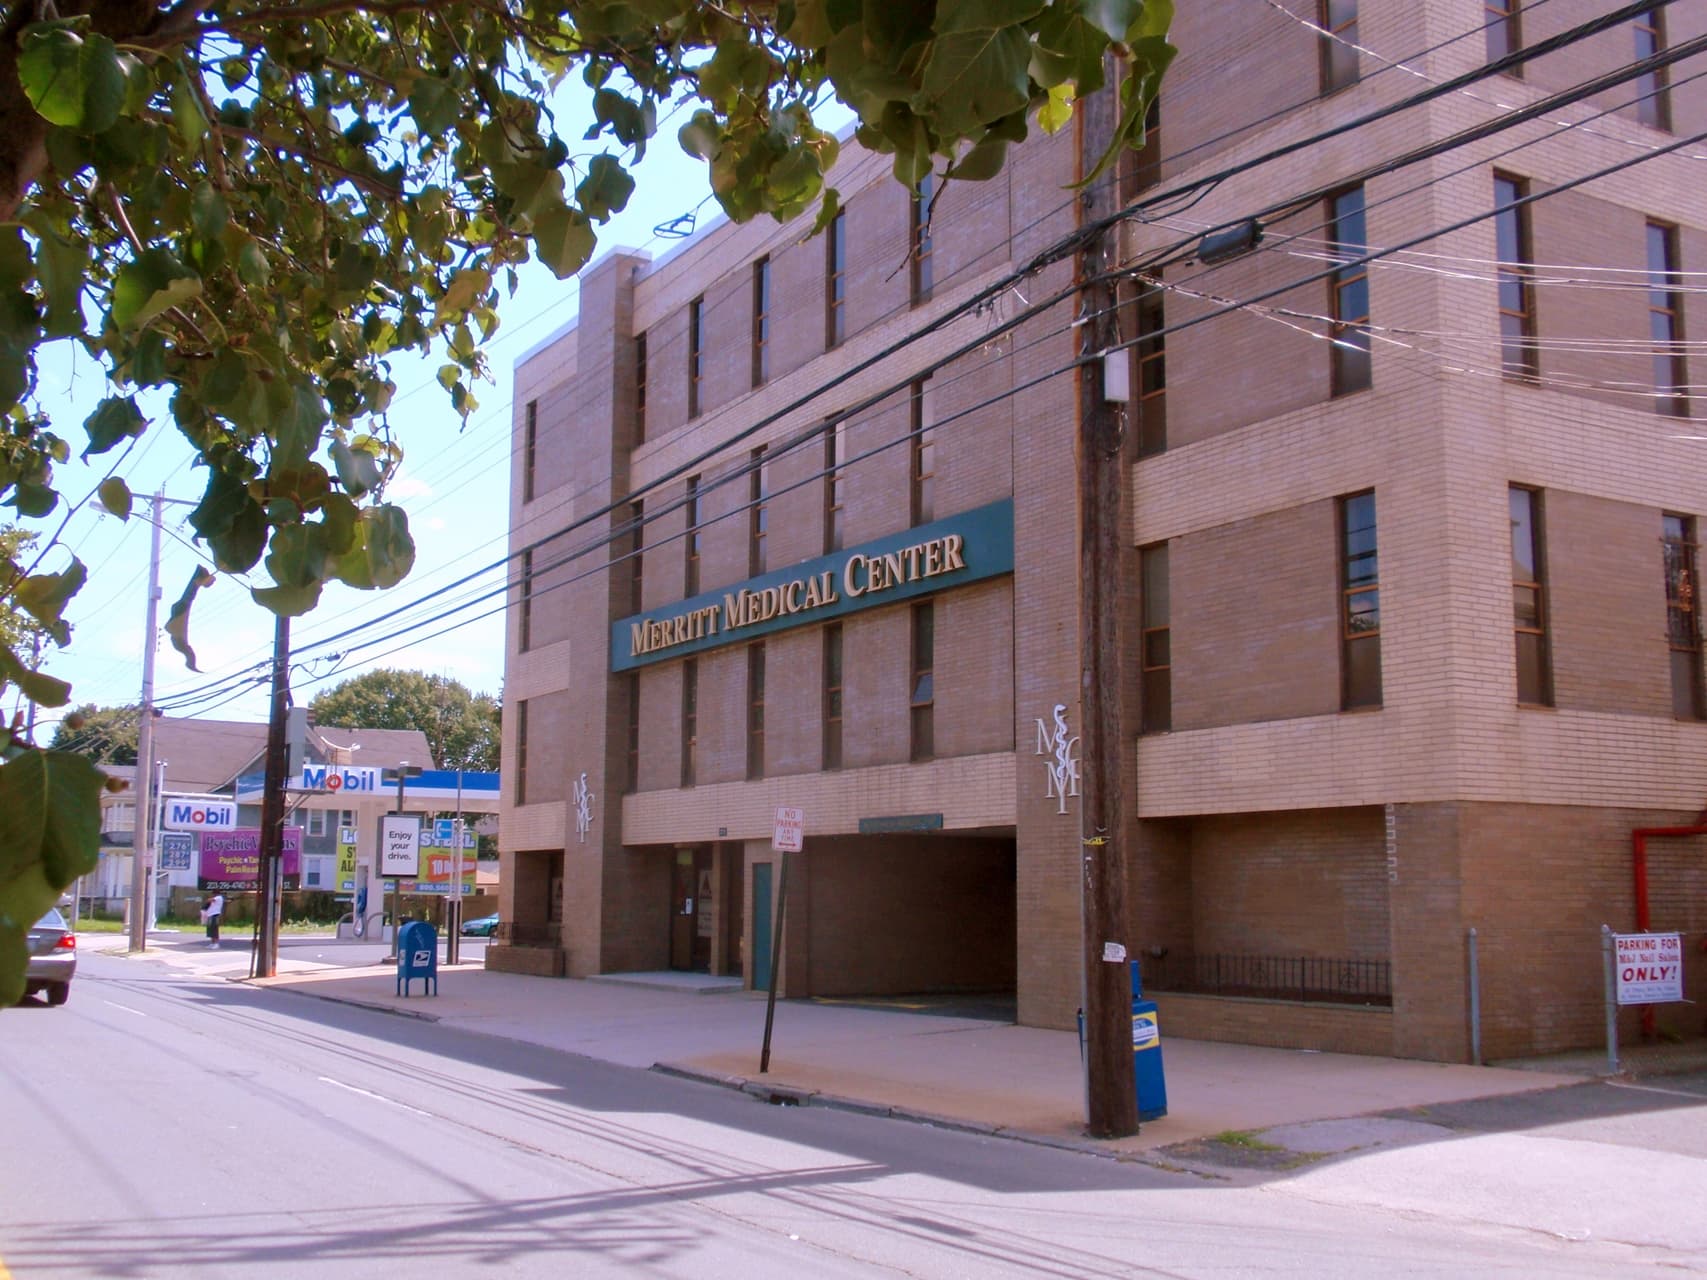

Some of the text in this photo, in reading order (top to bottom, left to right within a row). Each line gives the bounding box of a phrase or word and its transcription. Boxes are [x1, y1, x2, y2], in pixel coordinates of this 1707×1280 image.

[630, 533, 967, 656] MERRITT MEDICAL CENTER
[303, 768, 375, 791] Mobil
[172, 805, 231, 825] Mobil
[784, 810, 796, 819] NO
[777, 820, 801, 828] PARKING
[389, 830, 412, 841] Enjoy
[390, 842, 410, 851] your
[387, 851, 412, 861] drive.
[1618, 938, 1679, 951] PARKING FOR
[1622, 966, 1678, 982] ONLY!
